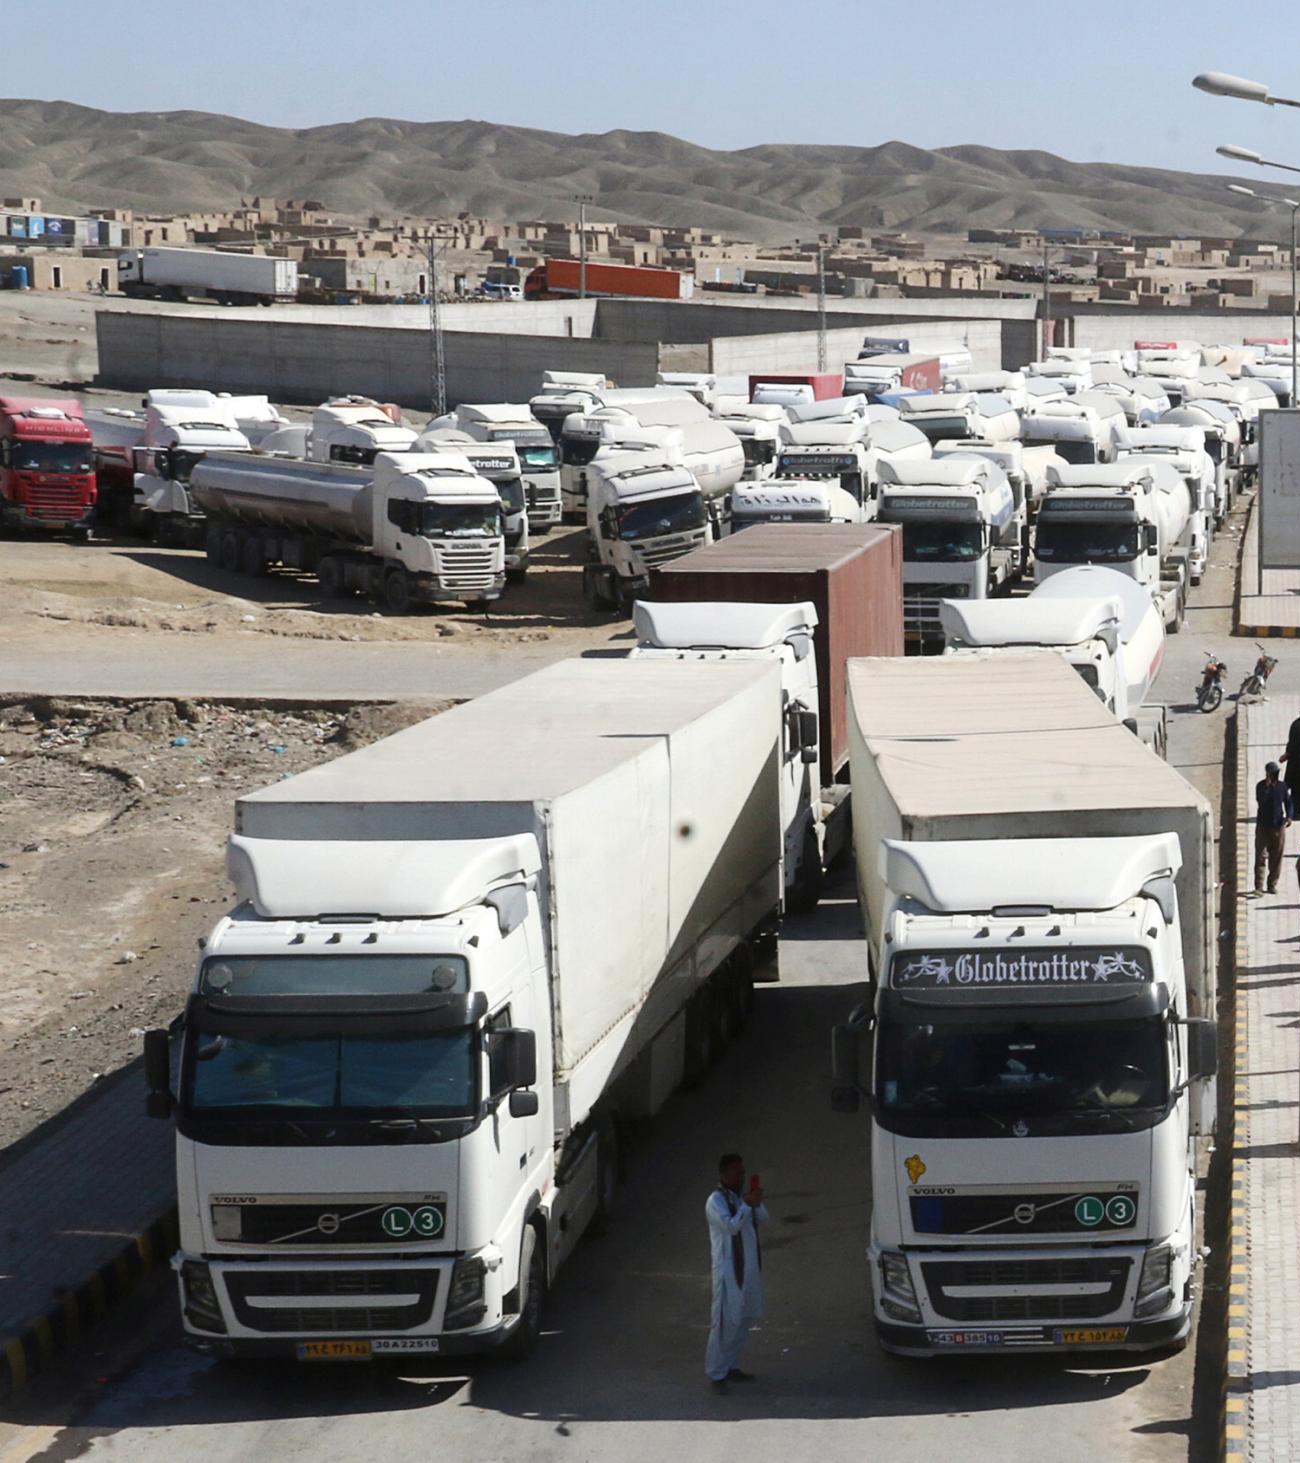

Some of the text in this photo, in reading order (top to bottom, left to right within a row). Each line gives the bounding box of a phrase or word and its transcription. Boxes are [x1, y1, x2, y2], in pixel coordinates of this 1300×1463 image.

[954, 953, 1092, 984] Globetrotter
[213, 1196, 258, 1204] VOLVO
[913, 1187, 956, 1195] VOLVO
[1084, 1202, 1126, 1220] L 3
[391, 1212, 434, 1231] L 3
